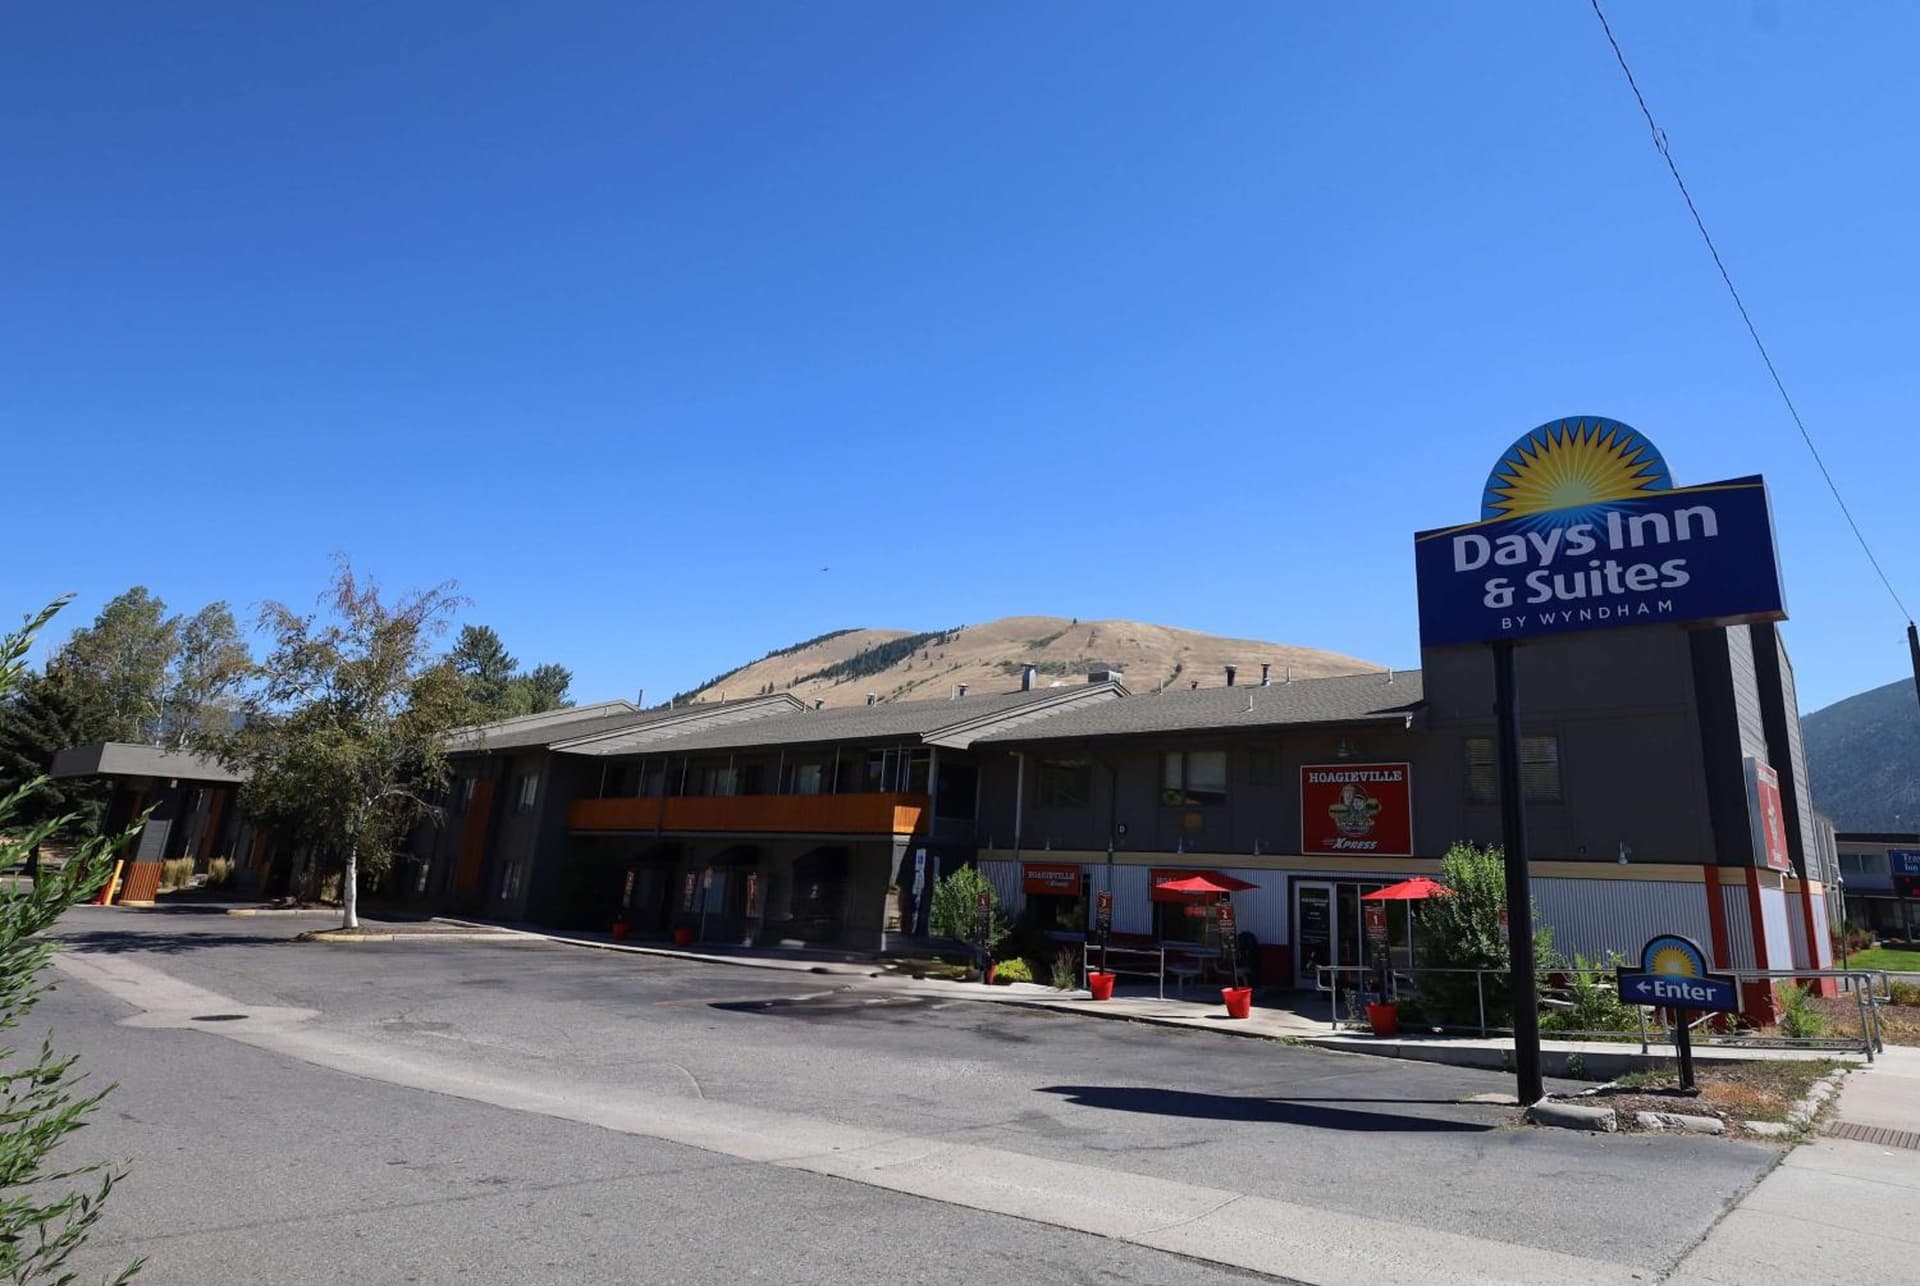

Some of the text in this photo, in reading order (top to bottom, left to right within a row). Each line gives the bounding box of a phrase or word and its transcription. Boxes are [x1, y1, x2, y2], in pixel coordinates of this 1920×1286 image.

[1453, 505, 1718, 572] Days Inn
[1483, 558, 1690, 609] & Suites
[1502, 600, 1673, 630] BY WYNDHAM
[1309, 771, 1403, 783] HOAGIEVILLE
[1654, 981, 1717, 1001] Enter
